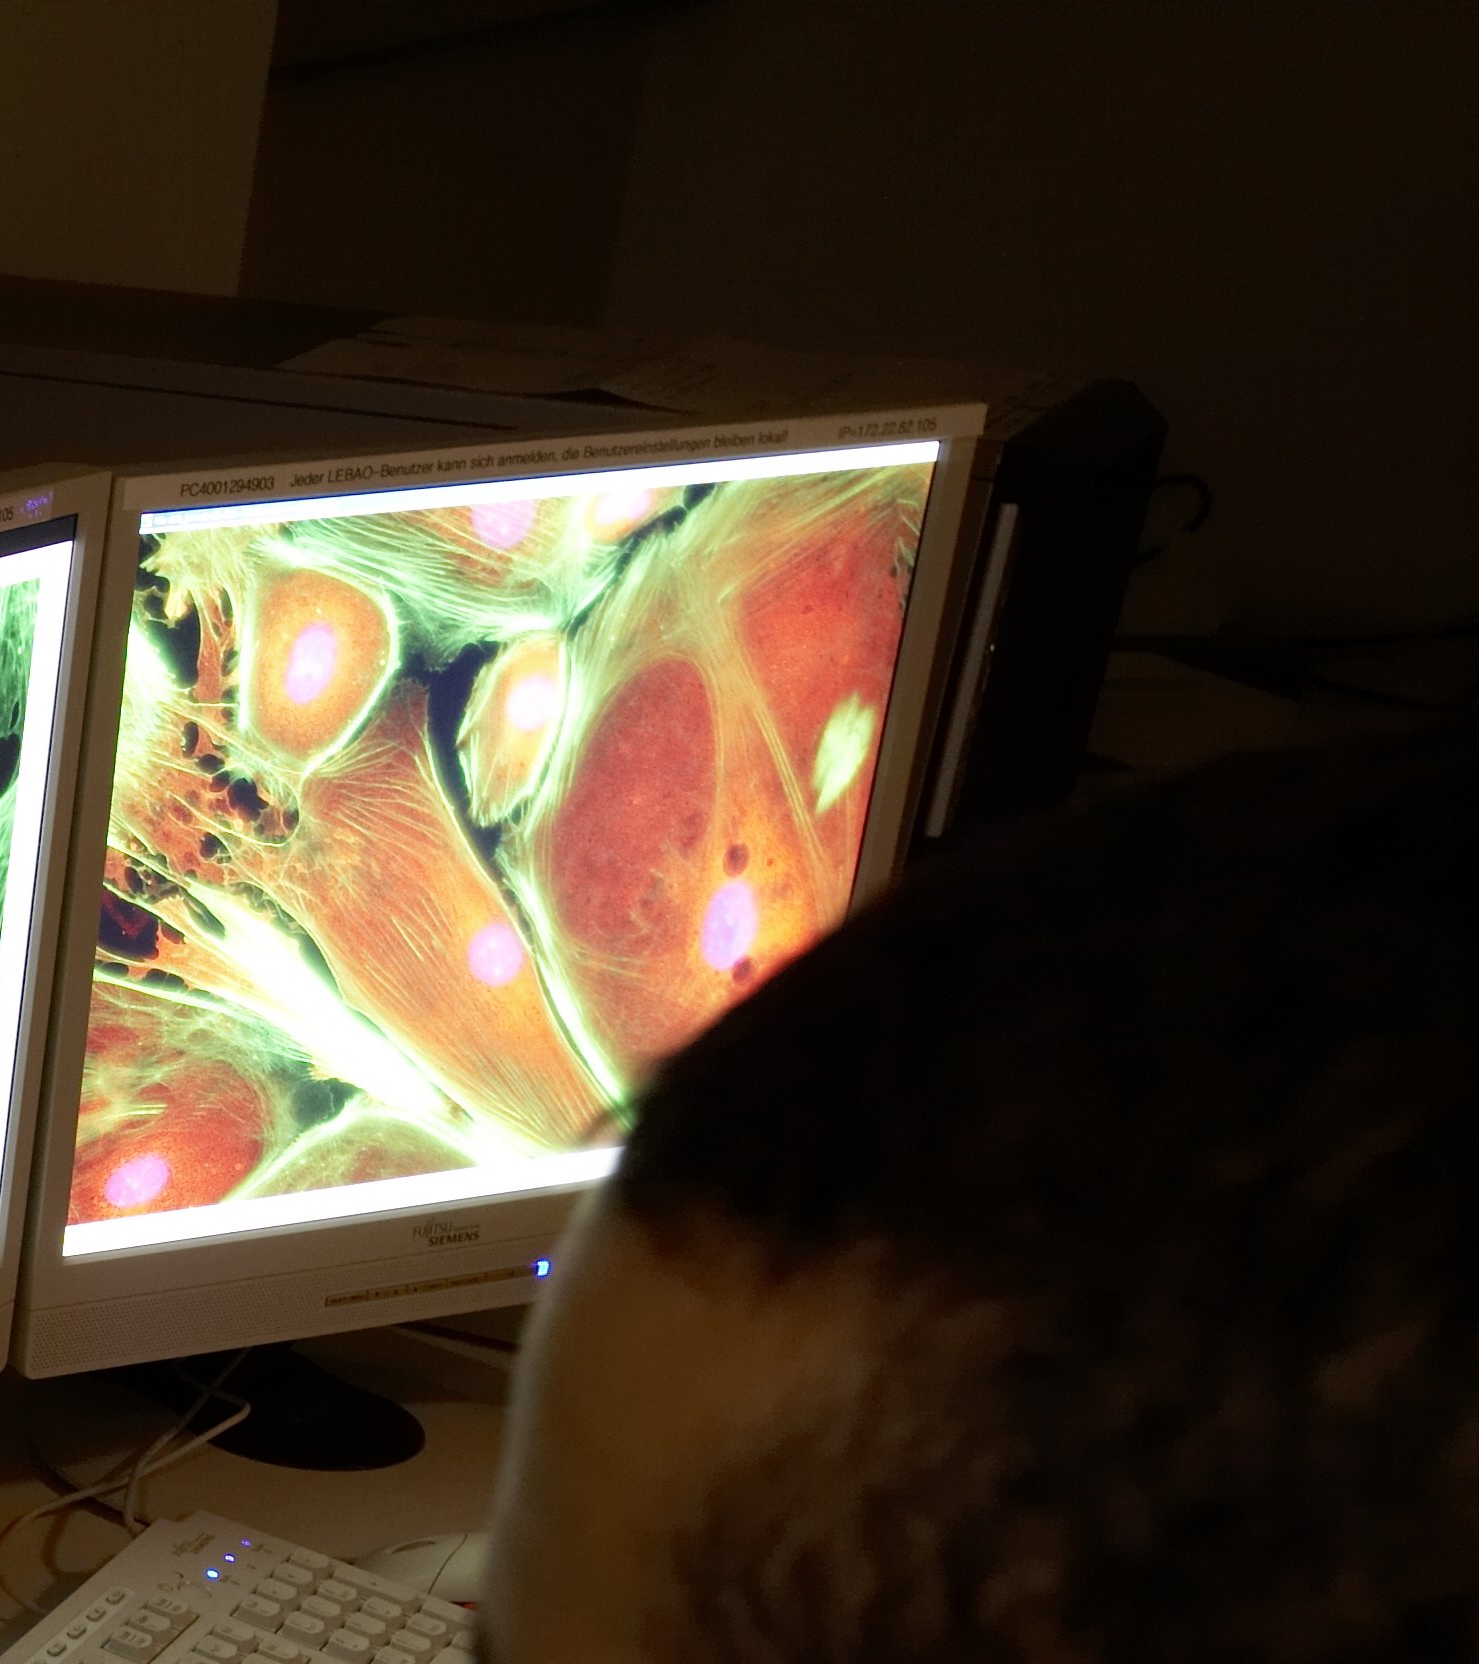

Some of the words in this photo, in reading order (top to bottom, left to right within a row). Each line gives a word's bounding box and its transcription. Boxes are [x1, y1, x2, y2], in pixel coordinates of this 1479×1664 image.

[180, 475, 275, 497] PC4001294903
[290, 472, 324, 488] Jeder
[327, 462, 434, 483] LEBAO-Benutzer
[437, 458, 467, 472] kann
[470, 455, 494, 469] sich
[498, 451, 558, 467] anmelden,
[562, 447, 580, 461] die
[713, 431, 755, 449] bleiben
[427, 1230, 480, 1247] SIEMENS
